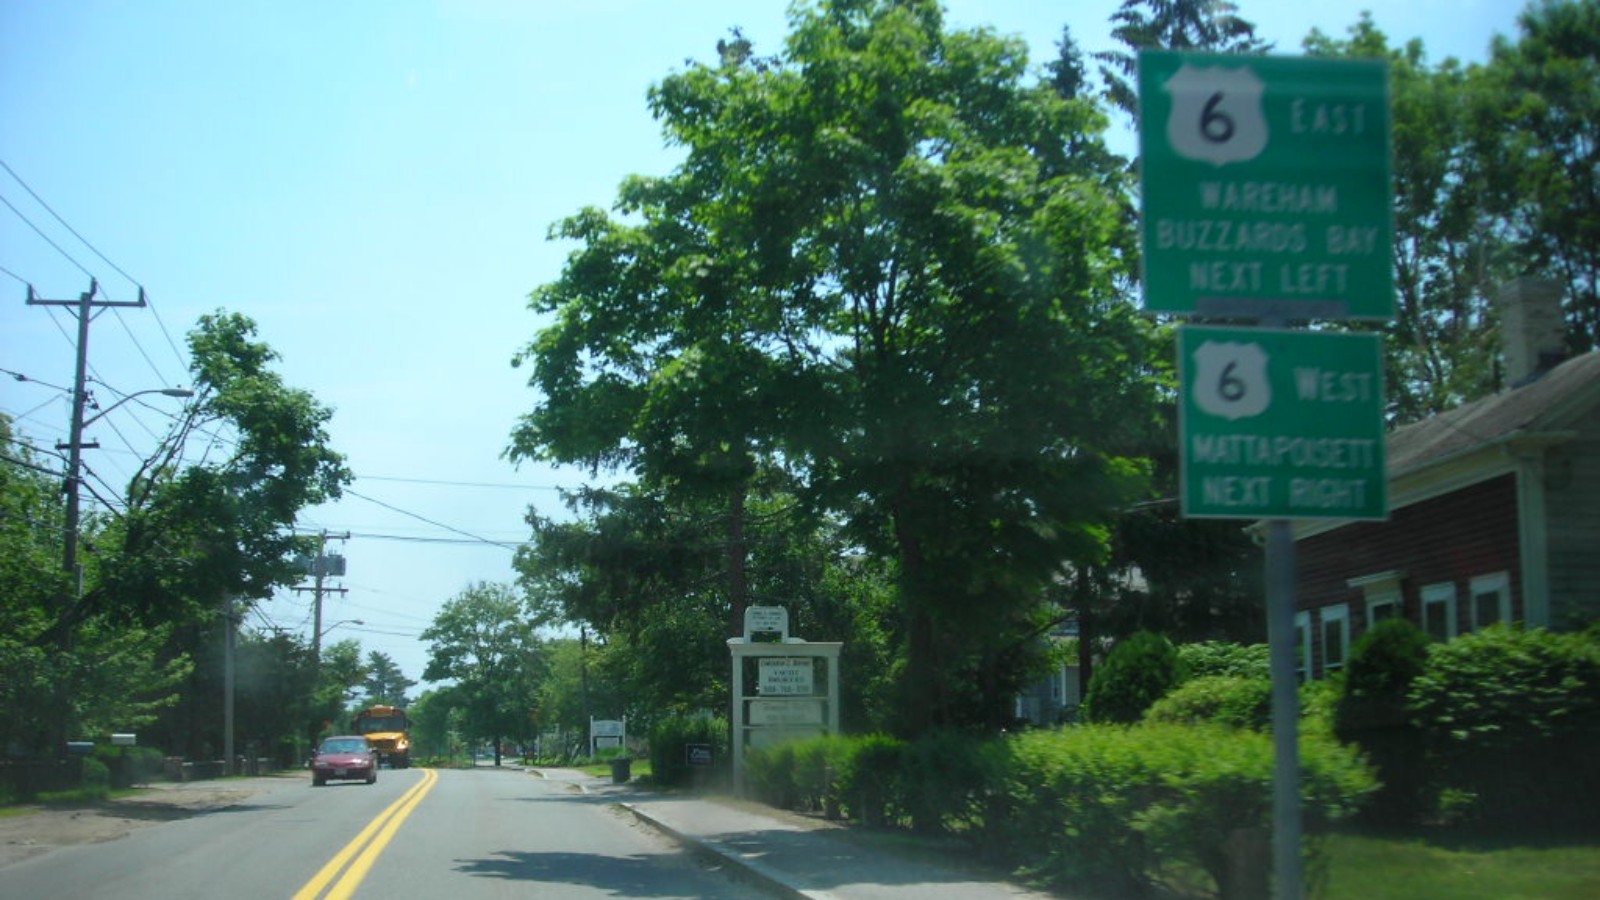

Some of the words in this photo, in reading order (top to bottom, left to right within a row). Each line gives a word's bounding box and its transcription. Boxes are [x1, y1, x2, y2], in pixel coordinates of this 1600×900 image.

[1199, 91, 1236, 143] 6
[1291, 99, 1366, 134] EAST
[1201, 181, 1337, 213] WAREHAM
[1157, 219, 1306, 252] BUZZARDS
[1327, 225, 1378, 254] BAY
[1191, 261, 1262, 291] NEXT
[1280, 264, 1348, 293] LEFT
[1218, 361, 1246, 402] 6
[1294, 367, 1371, 402] WEST
[1192, 434, 1376, 467] MATTAPOISETT
[1203, 476, 1271, 505] NEXT
[1289, 477, 1366, 508] RIGHT
